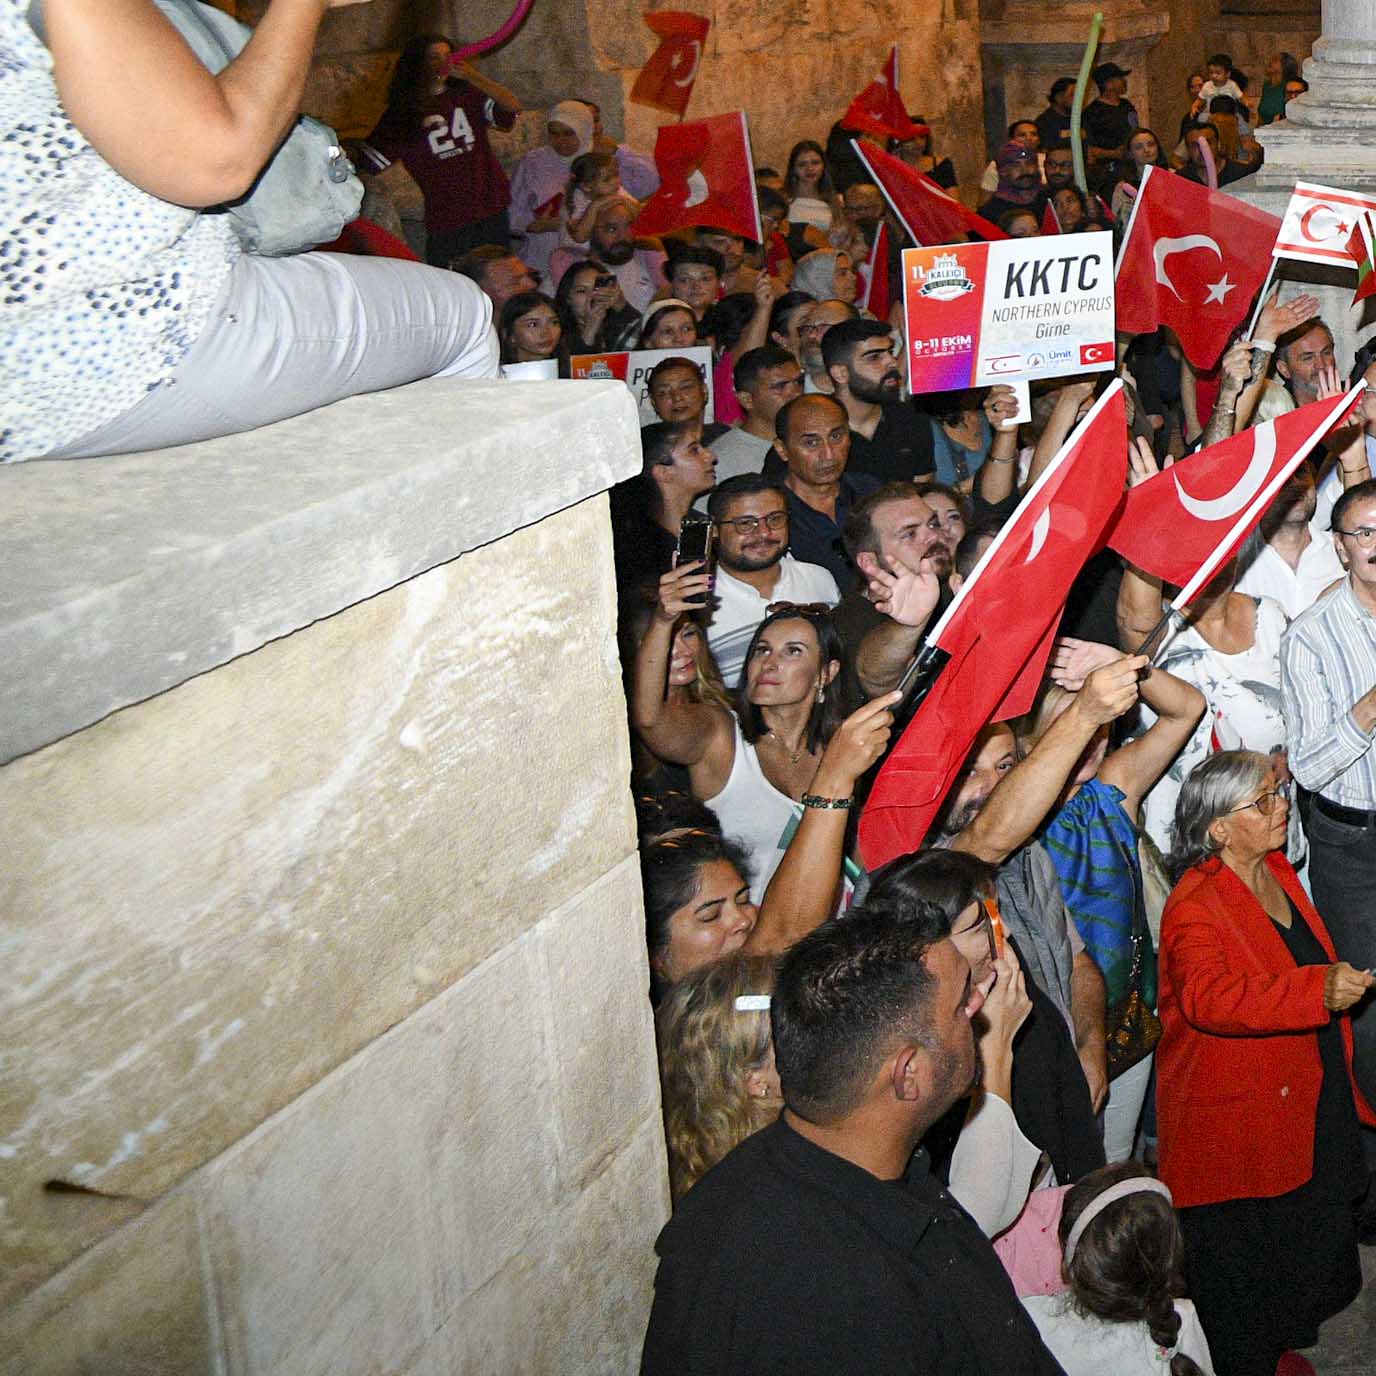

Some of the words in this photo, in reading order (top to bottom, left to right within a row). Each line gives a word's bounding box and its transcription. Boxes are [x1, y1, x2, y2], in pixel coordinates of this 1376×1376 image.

[423, 107, 475, 154] 24
[1004, 254, 1101, 299] KKTC
[992, 302, 1060, 323] NORTHERN
[1063, 296, 1113, 316] CYPRUS
[914, 338, 939, 350] 8-11
[942, 334, 972, 346] EKİM
[1036, 323, 1071, 339] Girne
